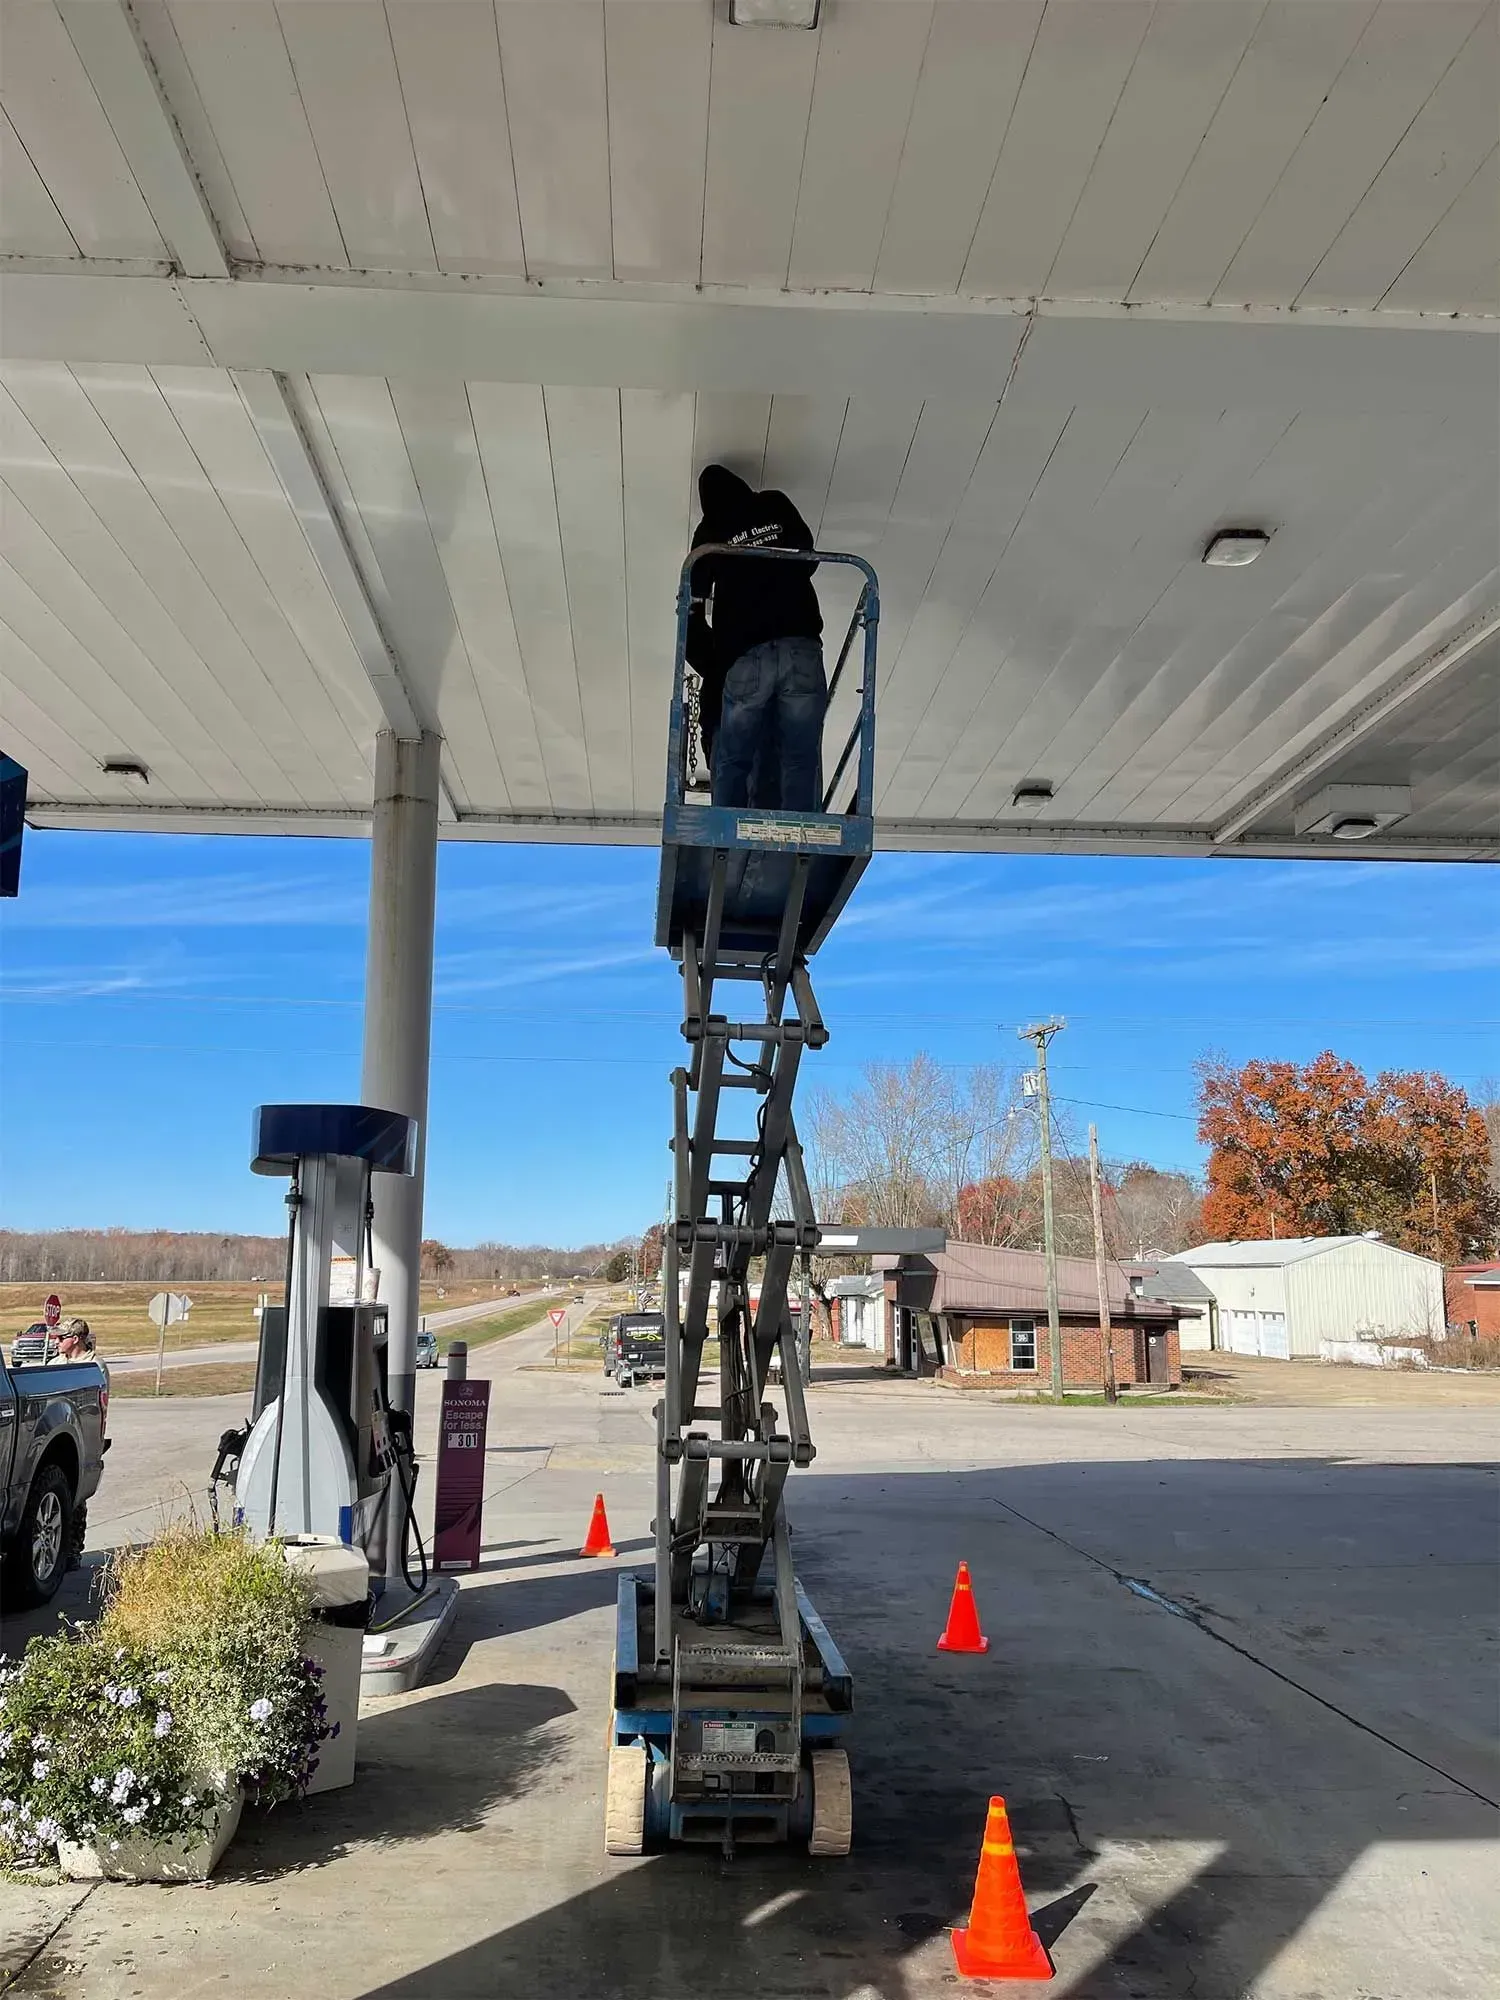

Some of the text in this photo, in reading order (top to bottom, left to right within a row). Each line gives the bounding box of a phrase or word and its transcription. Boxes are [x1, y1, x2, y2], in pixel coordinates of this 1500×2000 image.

[751, 524, 778, 536] Electric
[46, 1303, 60, 1317] STOP
[444, 1399, 486, 1407] SONOMA
[445, 1410, 484, 1422] Escape
[443, 1420, 484, 1430] for less.
[458, 1434, 477, 1447] 301
